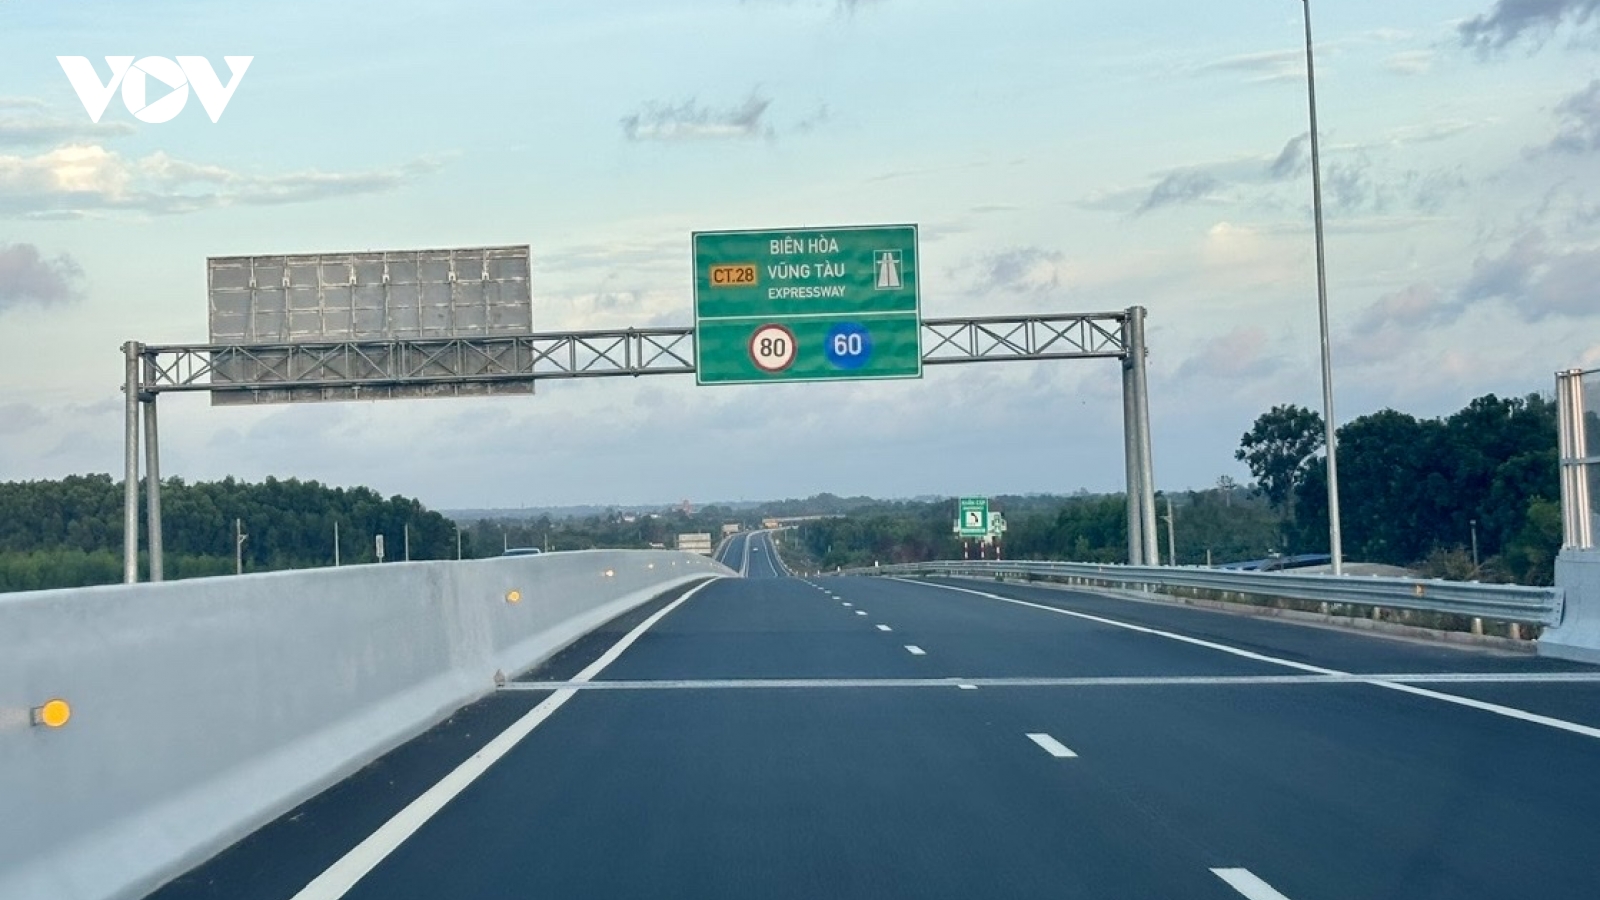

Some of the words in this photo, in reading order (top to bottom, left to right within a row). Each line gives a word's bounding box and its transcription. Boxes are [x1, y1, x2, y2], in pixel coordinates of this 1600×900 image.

[770, 236, 803, 255] BIÊN
[808, 234, 839, 253] HÒA
[713, 268, 755, 284] CT.28
[767, 262, 810, 279] VŨNG
[814, 260, 845, 278] TÀU
[768, 286, 846, 299] EXPRESSWAY
[760, 338, 786, 357] 80
[834, 333, 862, 355] 60
